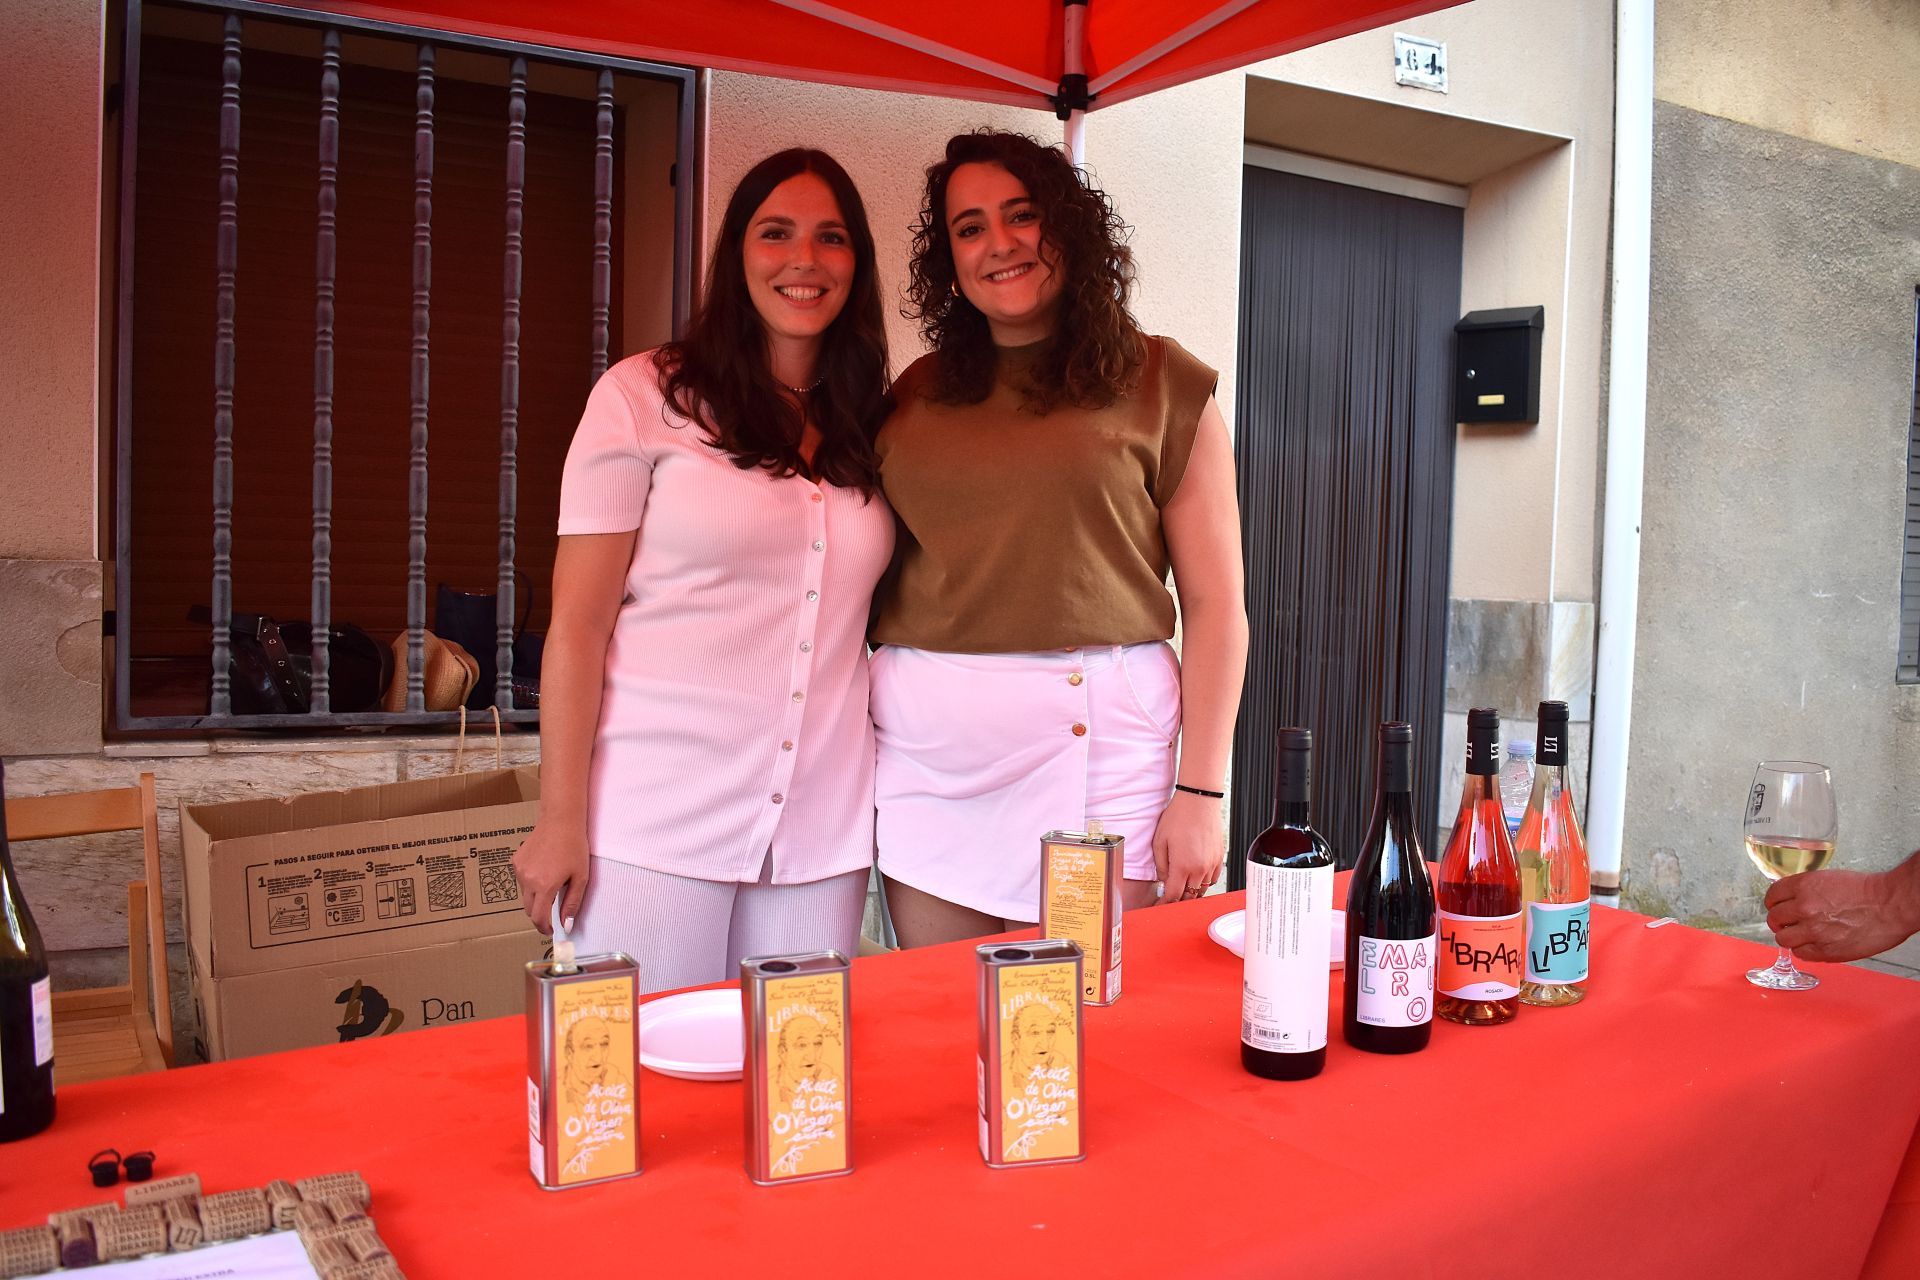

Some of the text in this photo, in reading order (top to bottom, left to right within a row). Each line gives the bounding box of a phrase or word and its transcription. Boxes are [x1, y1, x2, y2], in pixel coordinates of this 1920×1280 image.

[274, 857, 298, 866] PASOS
[307, 852, 334, 861] SEGUIR
[336, 850, 355, 859] PARA
[357, 844, 390, 855] OBTENER
[402, 840, 426, 849] MEJOR
[428, 835, 467, 846] RESULTADO
[480, 829, 515, 838] NUESTROS
[516, 826, 536, 834] PROD
[469, 848, 478, 859] 5
[365, 861, 374, 873] 3
[415, 855, 425, 866] 4
[313, 868, 323, 880] 2
[258, 876, 267, 888] 1
[1440, 919, 1522, 976] LIBRAR
[421, 998, 476, 1026] Pan
[1360, 1014, 1386, 1024] LIBRARES
[1028, 1065, 1071, 1082] Aceite
[588, 1083, 628, 1099] Aceite
[796, 1077, 838, 1094] Aceite
[1025, 1081, 1039, 1096] de
[584, 1098, 596, 1114] de
[792, 1094, 807, 1109] de
